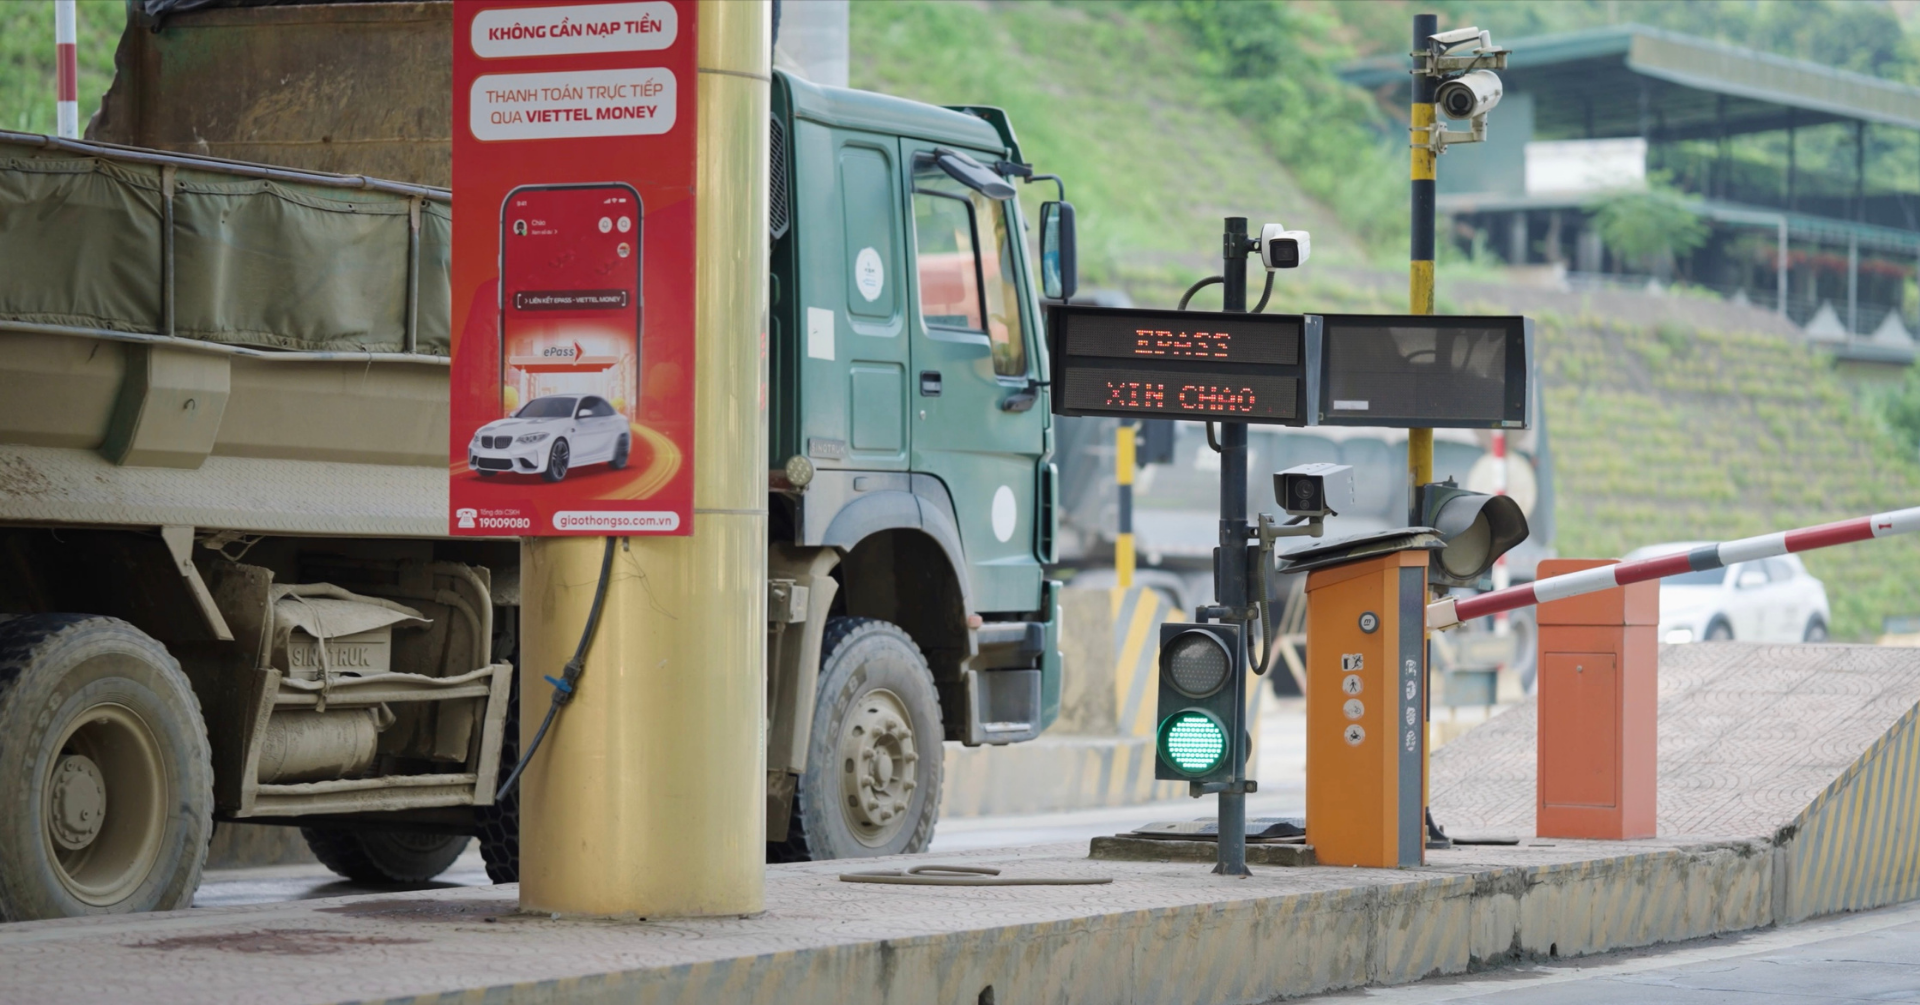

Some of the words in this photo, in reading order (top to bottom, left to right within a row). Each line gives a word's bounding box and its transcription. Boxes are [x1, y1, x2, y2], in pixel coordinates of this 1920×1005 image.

[489, 23, 546, 41] KHÔNG
[549, 17, 582, 38] CẦN
[586, 21, 621, 38] NẠP
[624, 13, 662, 34] TIỀN
[486, 89, 537, 103] THANH
[541, 84, 583, 101] TOÁN
[586, 84, 627, 100] TRỰC
[630, 77, 663, 97] TIẾP
[490, 111, 522, 125] QUA
[526, 108, 592, 123] VIETTEL
[596, 105, 657, 120] MONEY
[543, 346, 574, 357] ePass
[1107, 382, 1164, 408] XIN
[479, 517, 530, 528] 19009080
[560, 515, 672, 528] giaothongso.com.vn
